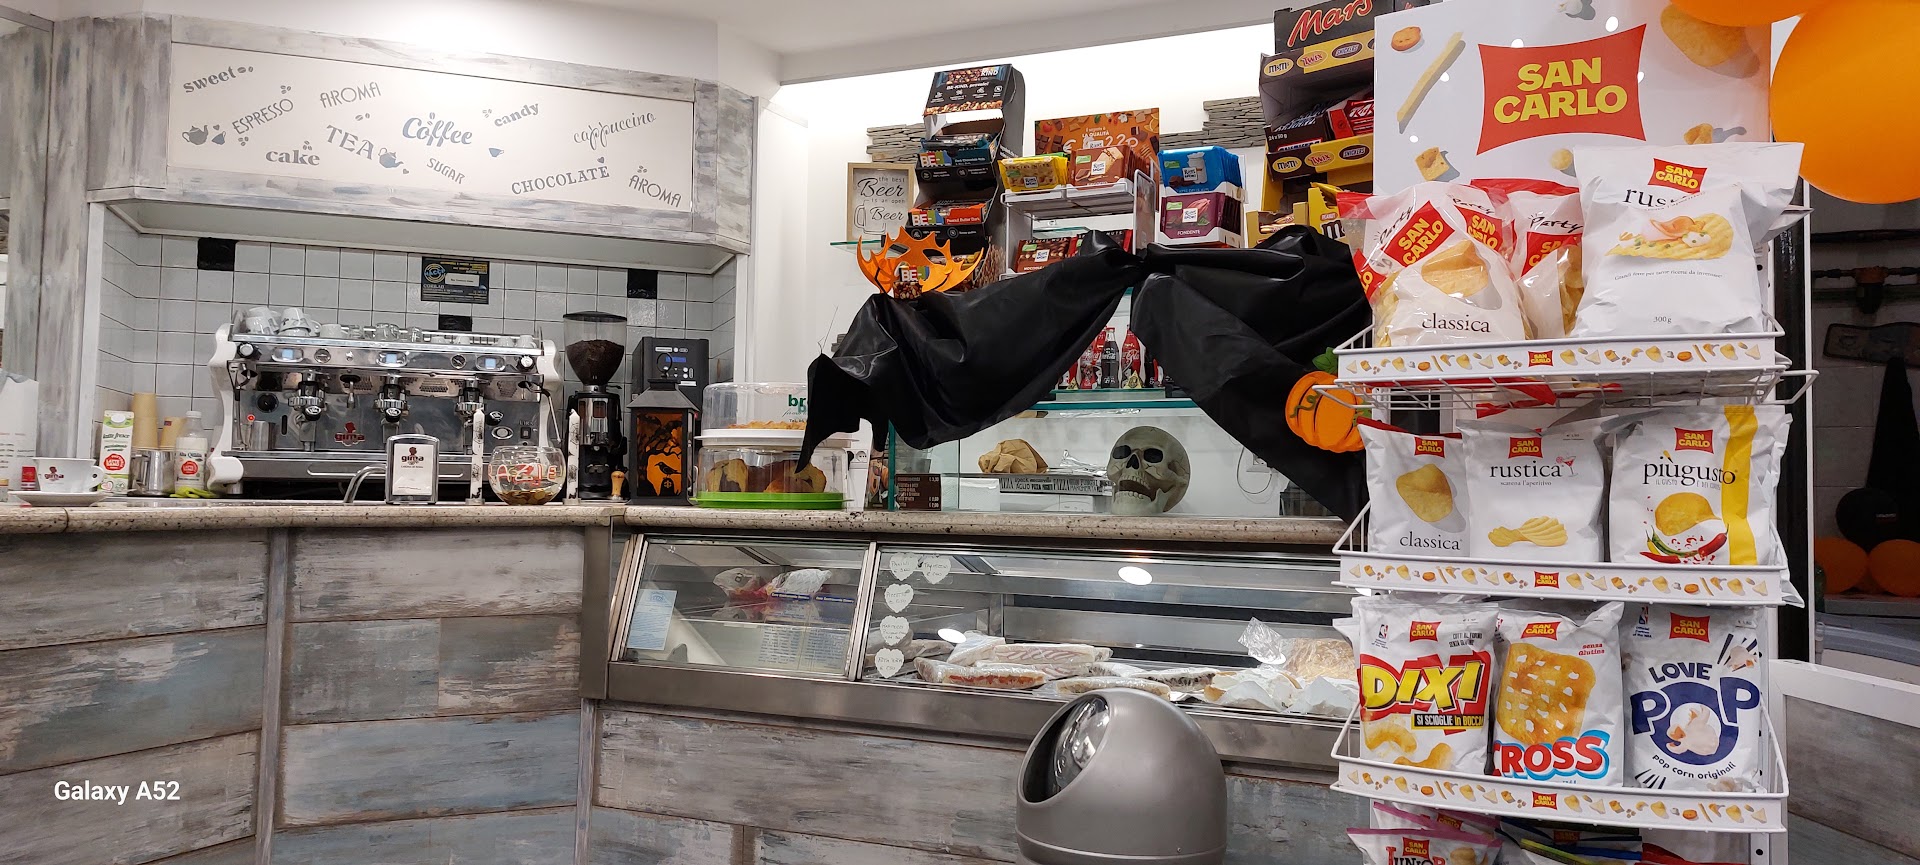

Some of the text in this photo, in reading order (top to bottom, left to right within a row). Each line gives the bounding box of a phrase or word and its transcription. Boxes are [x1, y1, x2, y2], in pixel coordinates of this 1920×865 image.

[1287, 0, 1373, 47] Mars
[183, 66, 236, 93] sweet
[1517, 57, 1602, 92] SAN
[320, 81, 382, 108] AROMA
[1493, 85, 1628, 124] CARLO
[232, 98, 294, 135] ESPRESSO
[494, 102, 540, 127] candy
[326, 124, 374, 160] TEA
[402, 116, 472, 147] Coffee
[573, 111, 657, 150] cappuccino
[265, 149, 320, 166] cake
[426, 157, 466, 185] SUGAR
[511, 165, 609, 195] CHOCOLATE
[1655, 170, 1699, 189] CARLO
[1665, 165, 1693, 177] SAN
[628, 174, 682, 208] AROMA
[858, 177, 904, 198] Beer
[869, 206, 904, 221] Beer
[1398, 218, 1431, 250] SAN
[1471, 215, 1496, 236] SAN
[1403, 220, 1444, 265] CARLO
[1422, 313, 1491, 333] classica
[1417, 445, 1443, 454] CARLO
[1511, 446, 1539, 454] CARLO
[1678, 438, 1710, 448] CARLO
[1490, 460, 1563, 478] rustica
[1642, 455, 1736, 486] piùgusto
[1399, 531, 1461, 551] classica
[1411, 629, 1436, 638] CARLO
[1673, 626, 1706, 636] CARLO
[1679, 619, 1701, 628] SAN
[1648, 661, 1712, 683] LOVE
[1361, 660, 1484, 711] DIXI
[1416, 715, 1424, 726] SI
[1424, 715, 1453, 726] SCIOGLIE
[1629, 676, 1760, 765] POP
[1652, 753, 1737, 780] pop corn originali
[1404, 847, 1428, 855] CARLO
[1408, 841, 1424, 849] SAN
